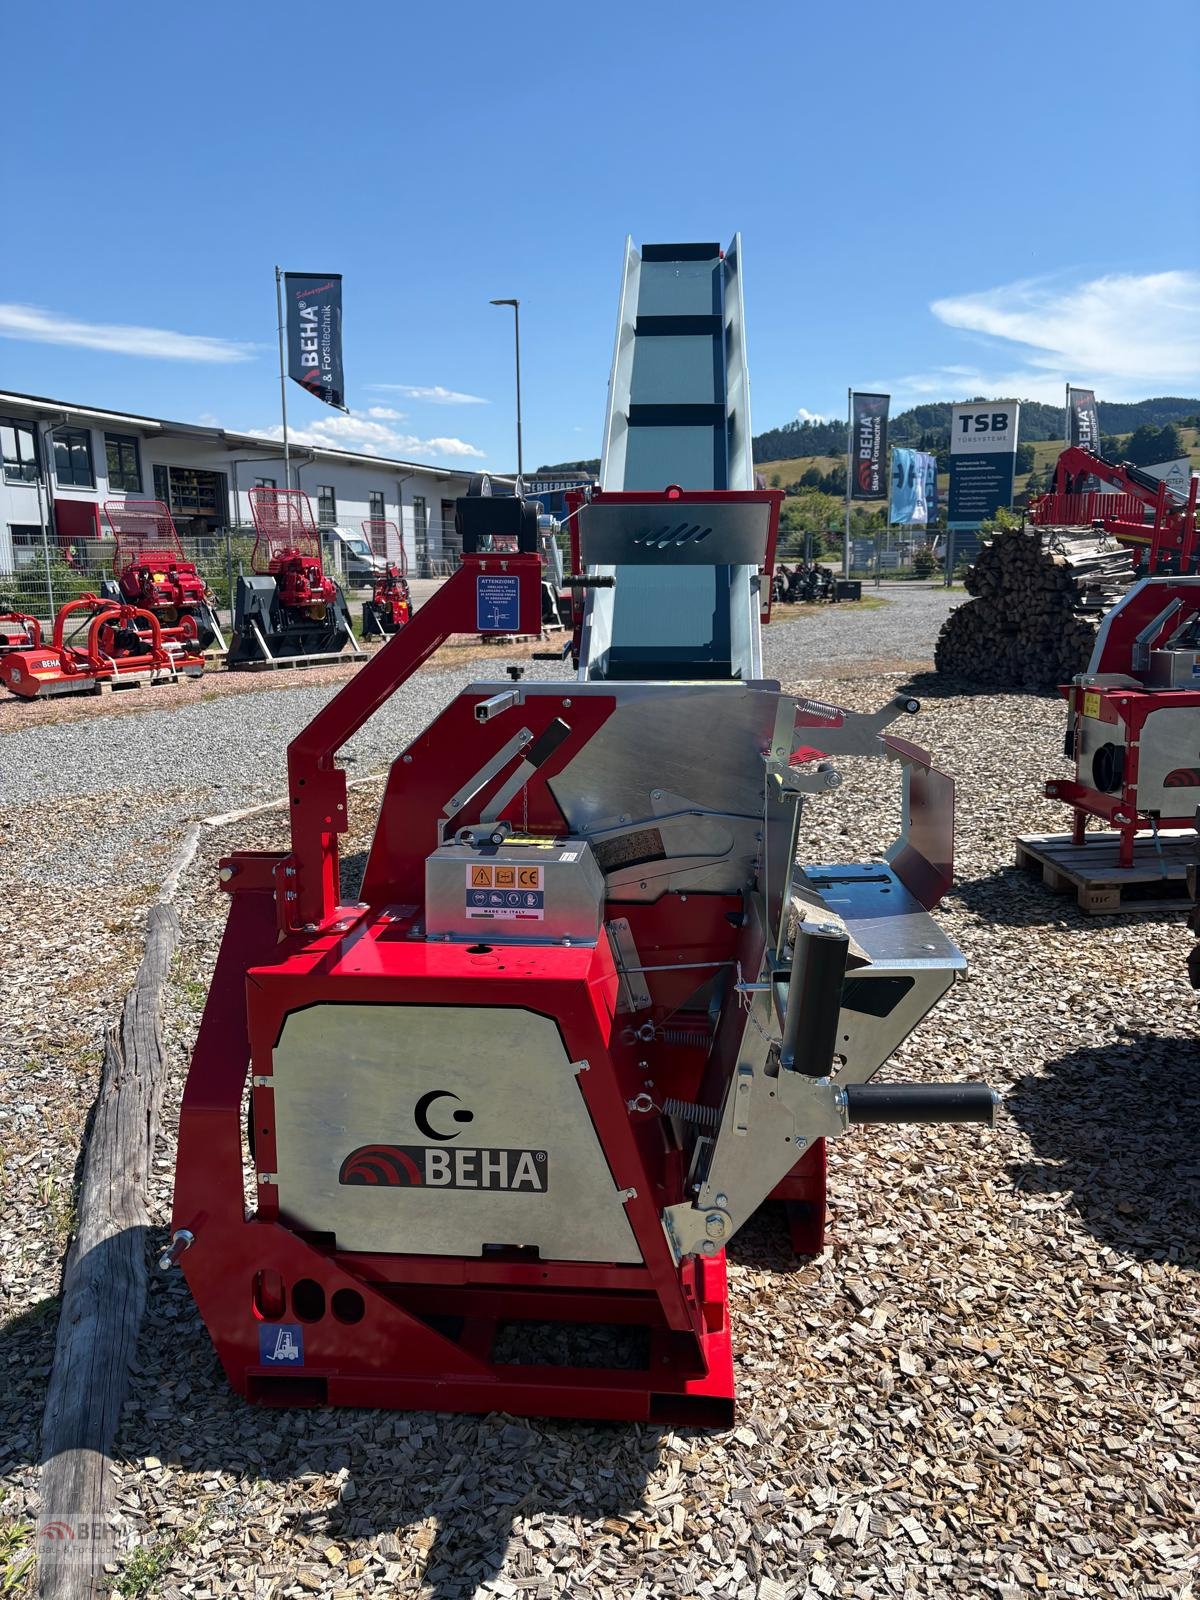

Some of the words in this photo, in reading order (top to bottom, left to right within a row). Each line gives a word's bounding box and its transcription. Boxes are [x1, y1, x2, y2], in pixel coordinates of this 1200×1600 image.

[321, 305, 333, 370] Forsttechnik
[324, 385, 333, 404] au-
[959, 413, 1009, 433] TSB
[41, 660, 61, 668] BEHA
[519, 871, 537, 885] CE
